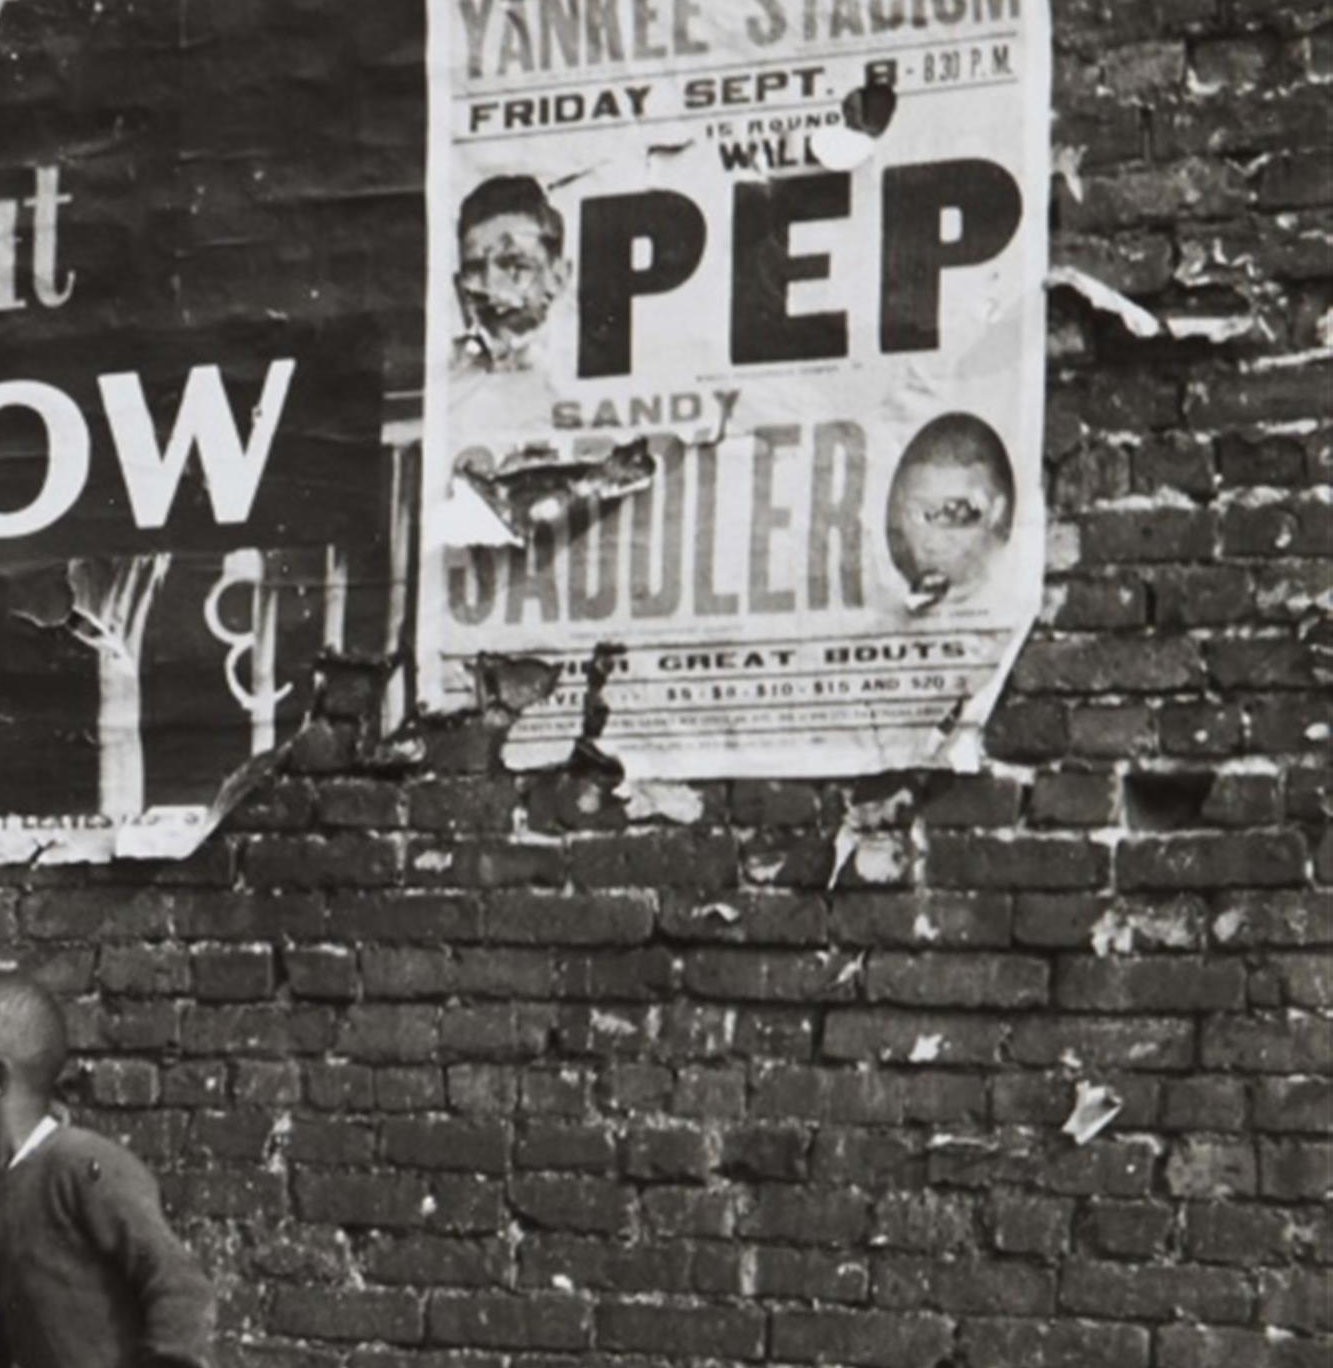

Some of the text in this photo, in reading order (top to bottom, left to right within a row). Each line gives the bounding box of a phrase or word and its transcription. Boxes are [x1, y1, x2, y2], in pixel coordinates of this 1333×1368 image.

[469, 87, 651, 133] FRIDAY
[684, 67, 833, 109] SEPT.
[748, 110, 842, 134] ROUND
[576, 157, 1024, 379] PEP
[551, 389, 740, 430] SANDY
[658, 641, 966, 672] GREAT BOUTS
[860, 676, 900, 693] AND
